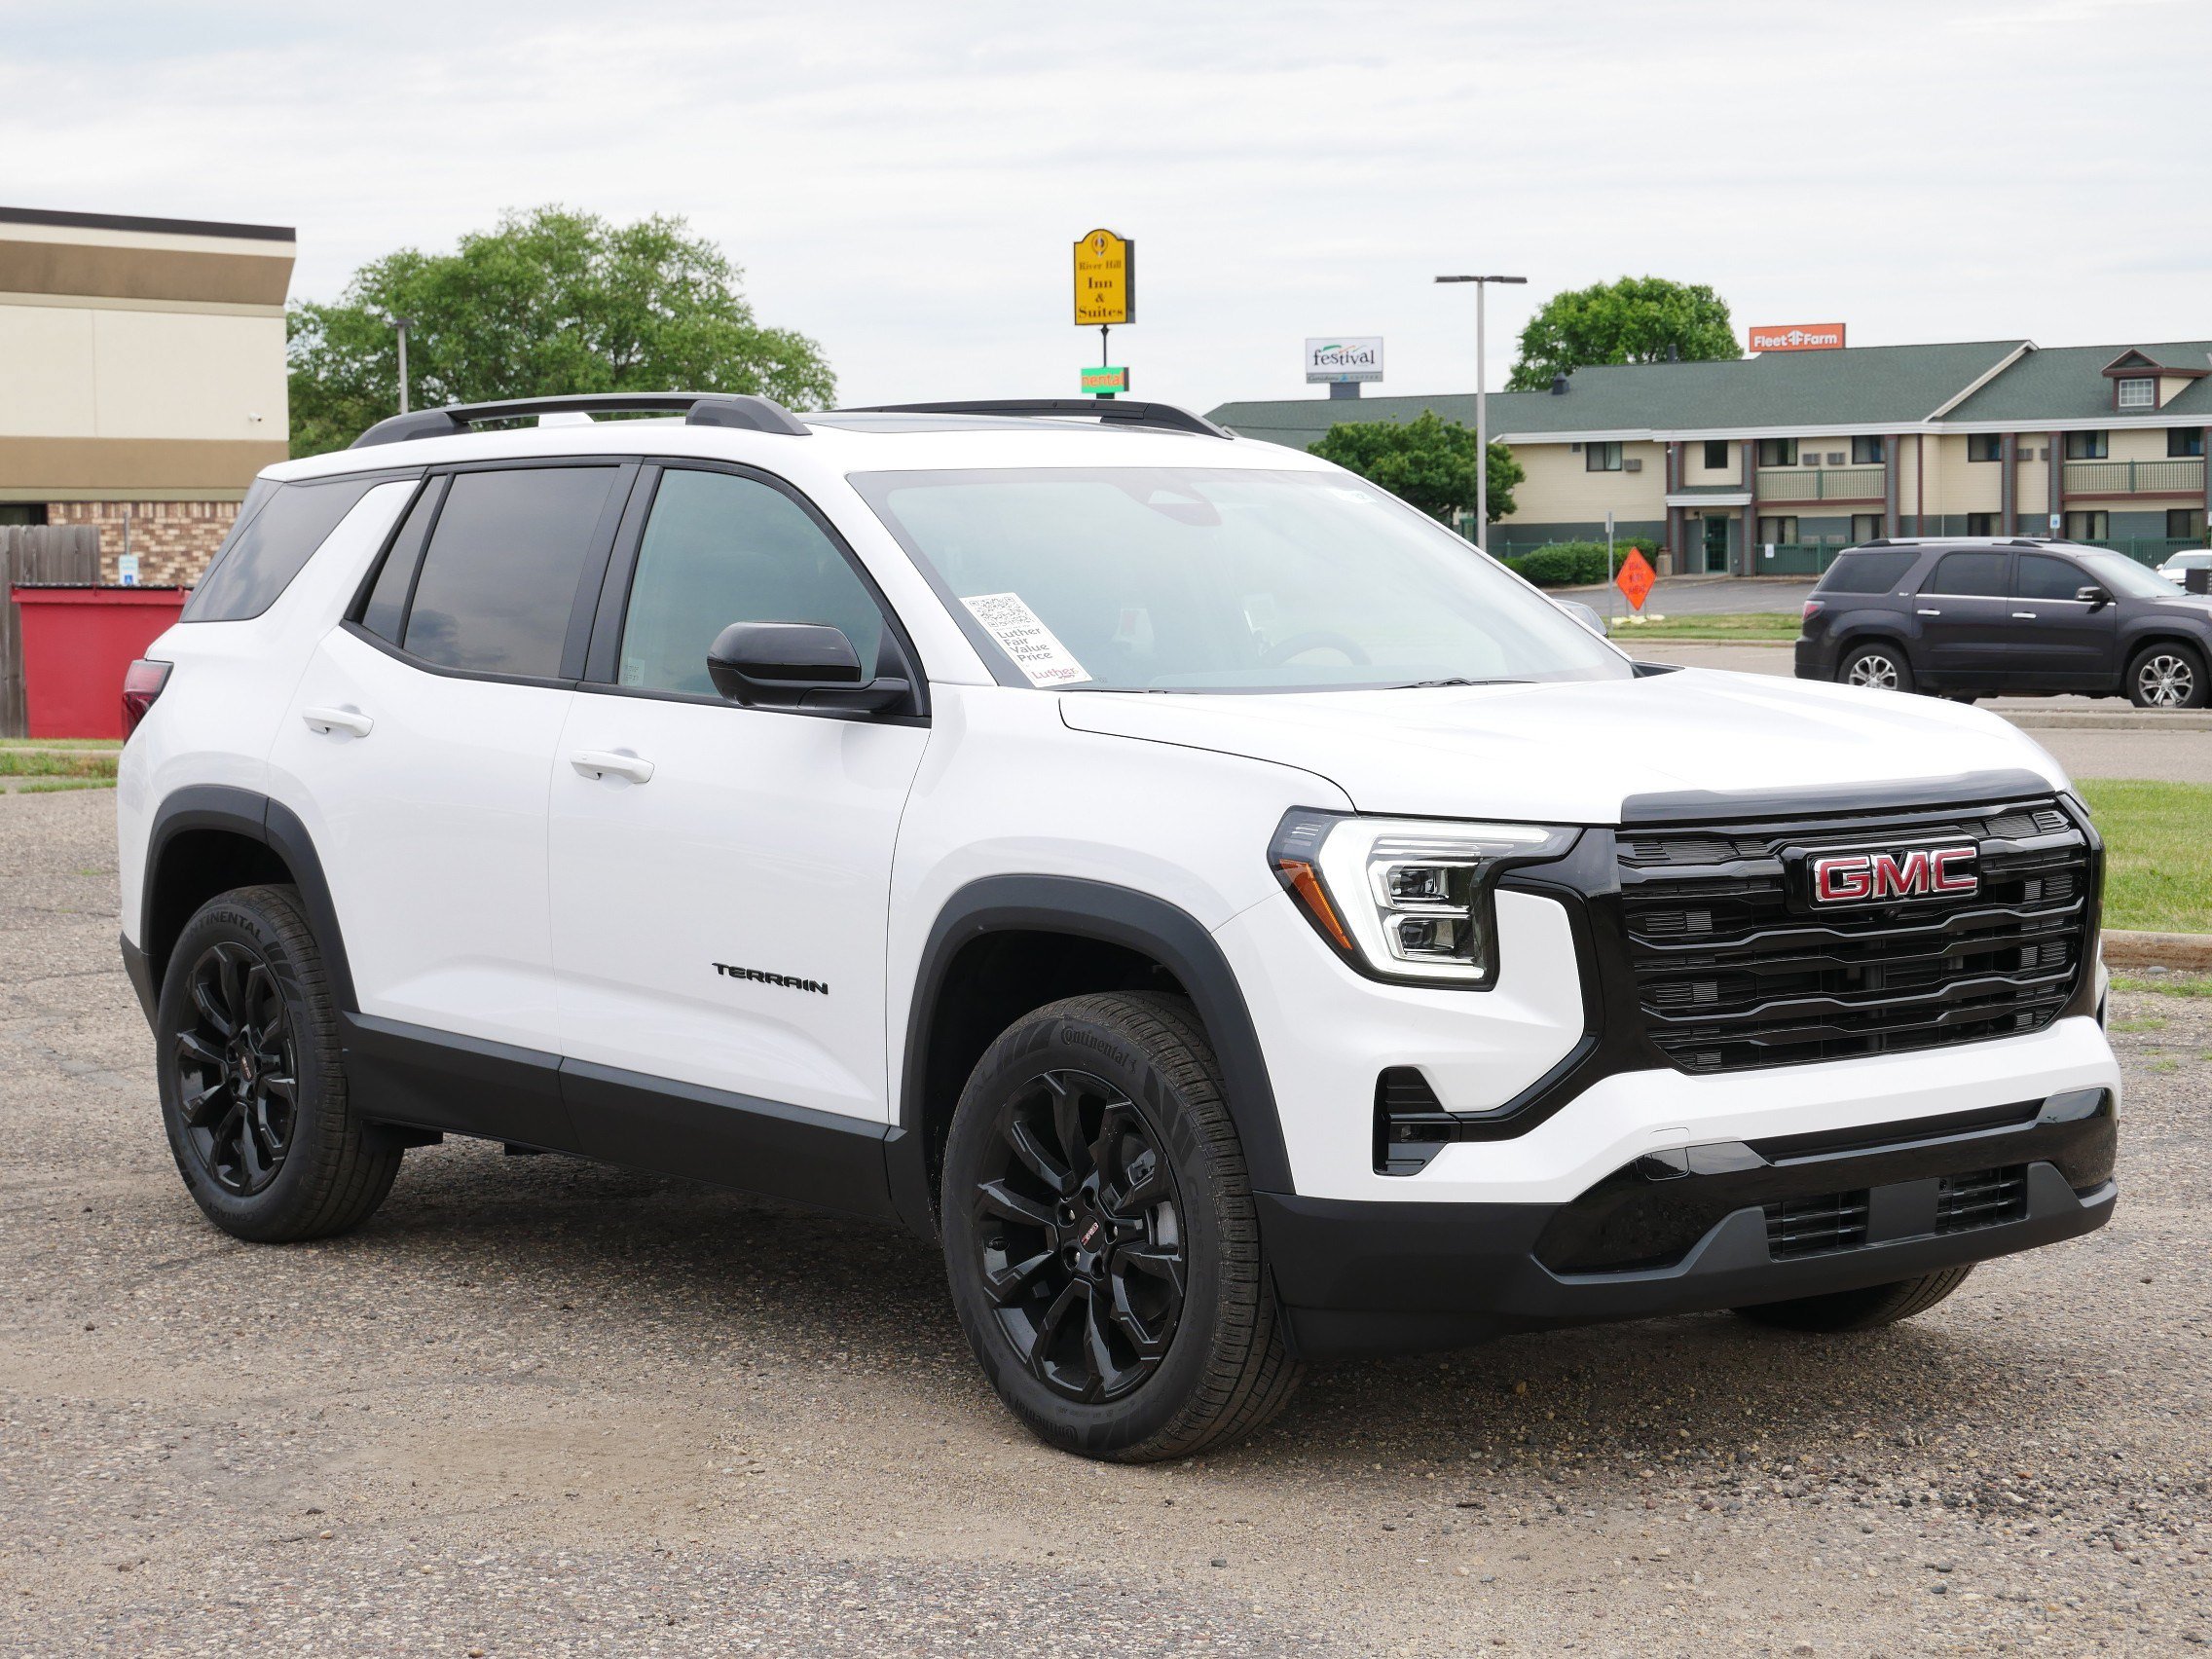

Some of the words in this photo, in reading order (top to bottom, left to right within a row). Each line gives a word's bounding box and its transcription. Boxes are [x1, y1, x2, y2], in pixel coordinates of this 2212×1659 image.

[1079, 261, 1102, 271] River
[1106, 260, 1122, 270] Hill
[1088, 277, 1113, 289] Inn
[1094, 293, 1105, 304] &
[1079, 307, 1124, 319] Suites
[1753, 335, 1788, 348] Fleet
[1804, 333, 1837, 346] Farm
[1313, 349, 1375, 367] festival
[996, 627, 1042, 639] Luther
[1003, 637, 1029, 646] Fair
[1009, 644, 1051, 654] Value
[1016, 652, 1053, 663] Price
[1031, 668, 1076, 680] Luther
[1814, 846, 1979, 903] GMC
[183, 910, 264, 944] NTINENTAL
[711, 962, 830, 995] TERRAIN
[1060, 1025, 1130, 1068] Continental
